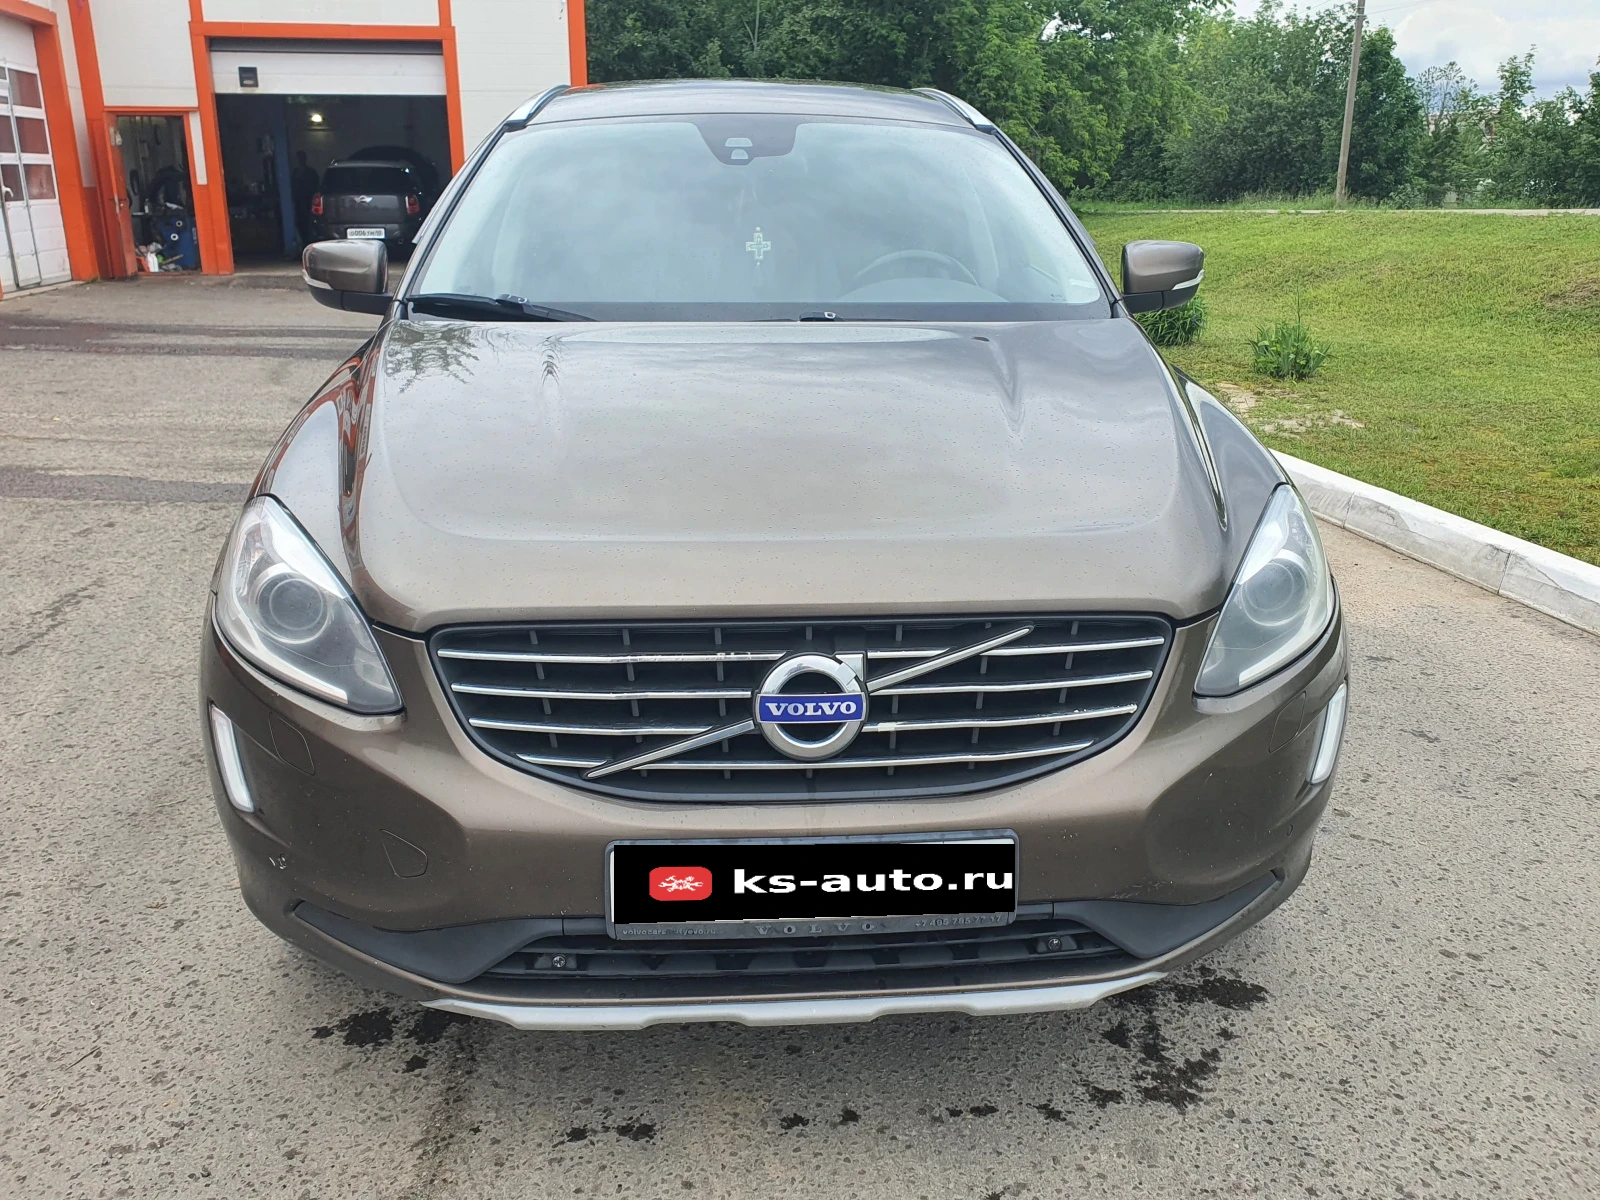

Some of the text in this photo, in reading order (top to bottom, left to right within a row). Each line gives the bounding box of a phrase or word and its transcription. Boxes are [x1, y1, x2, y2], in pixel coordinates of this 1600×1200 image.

[765, 701, 857, 716] VOLVO
[755, 922, 875, 935] VOLVO
[929, 918, 949, 926] 495
